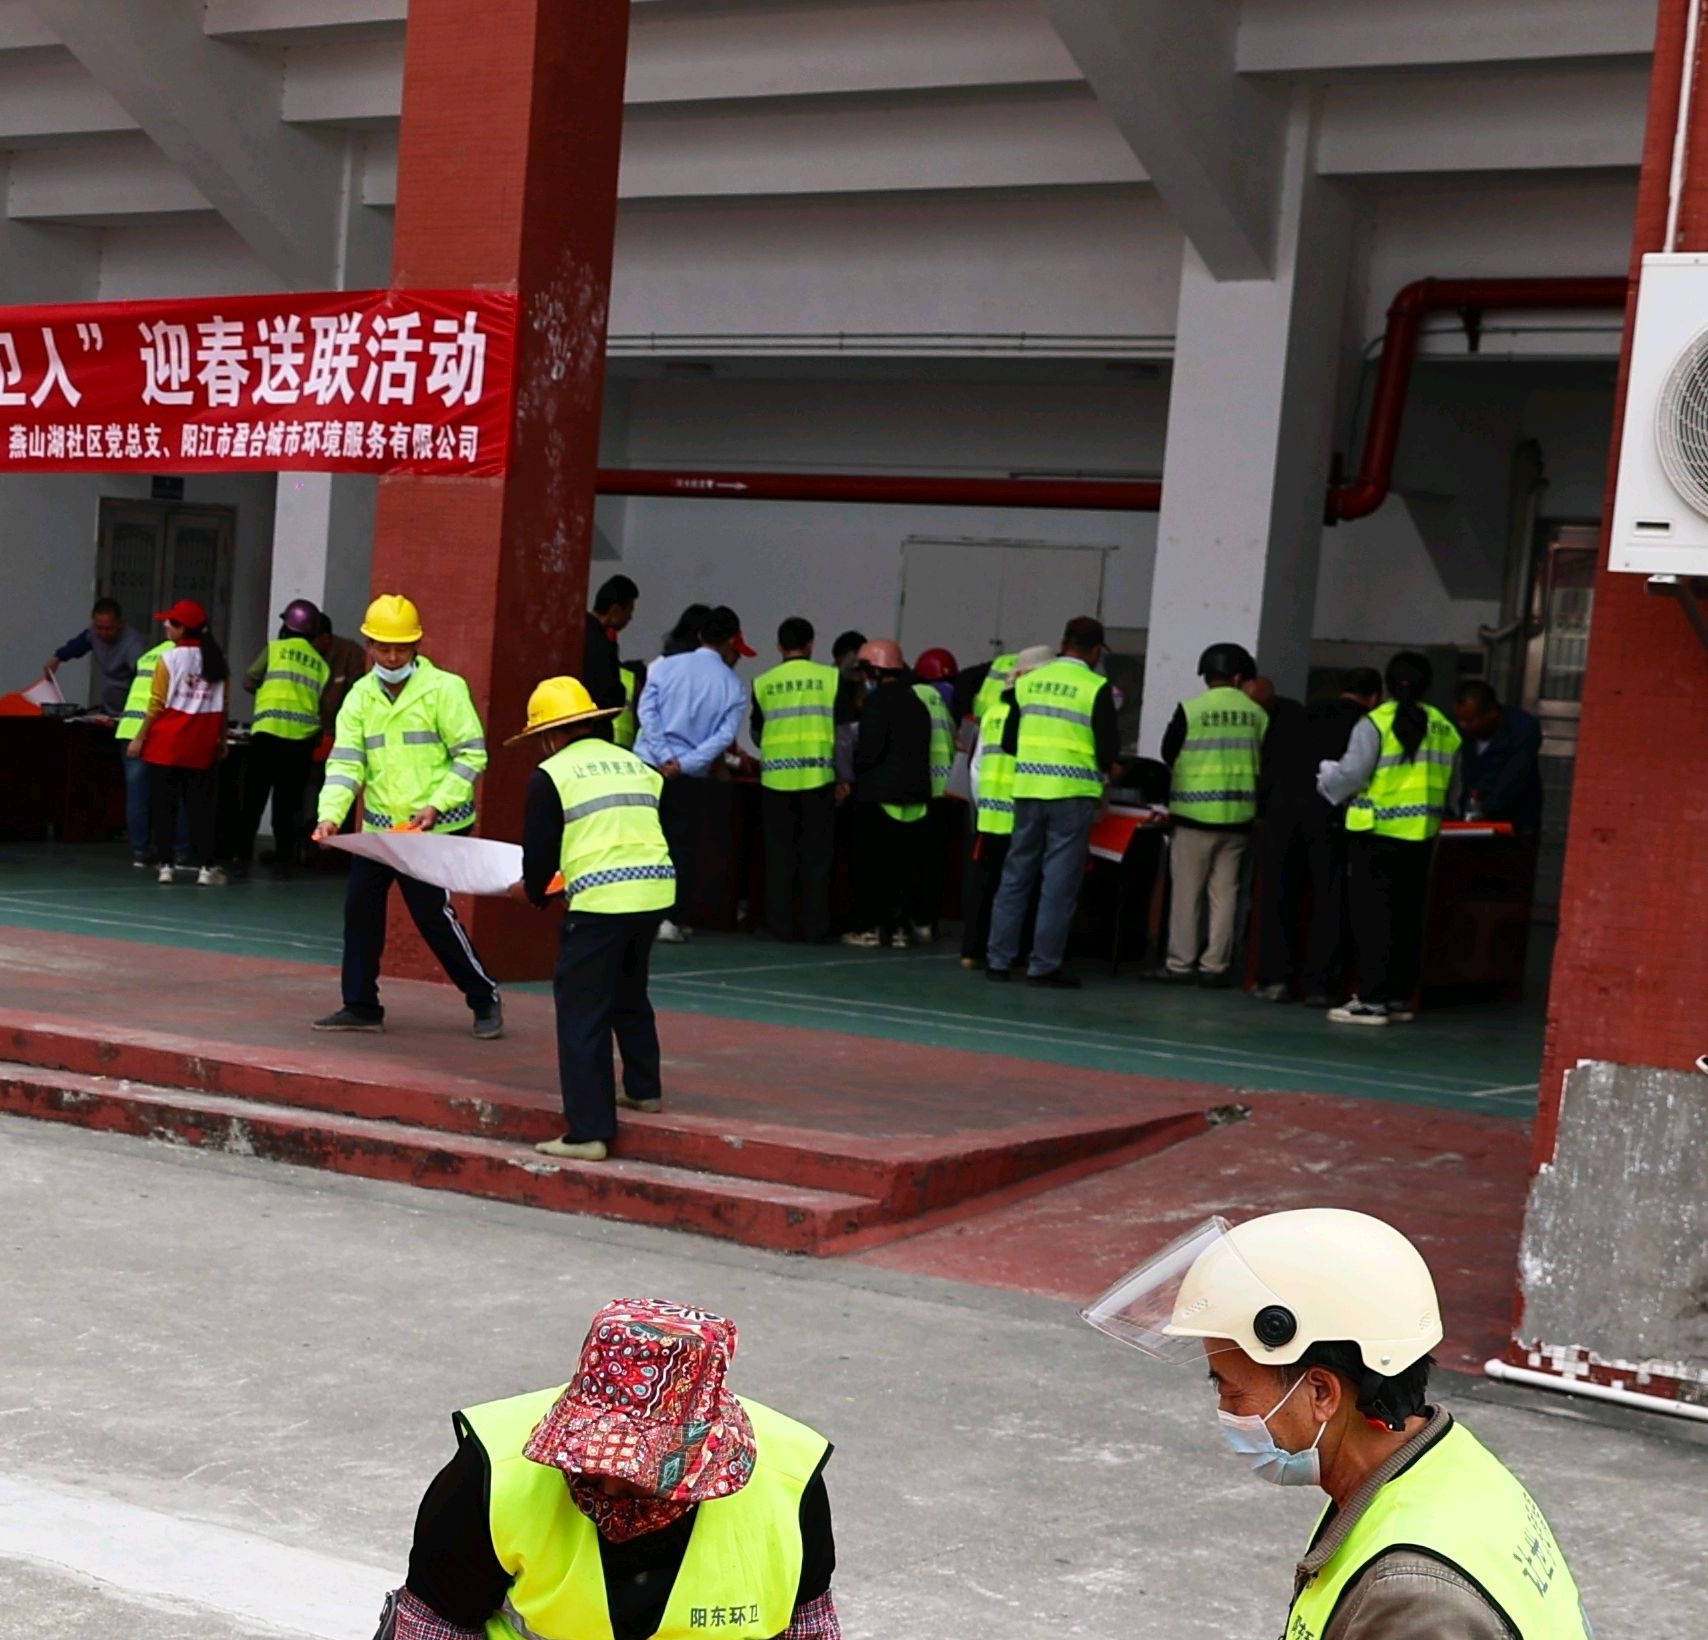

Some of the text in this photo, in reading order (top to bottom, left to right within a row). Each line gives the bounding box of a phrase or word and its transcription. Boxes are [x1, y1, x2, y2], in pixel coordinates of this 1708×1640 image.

[139, 310, 487, 407] 迎春送联活动
